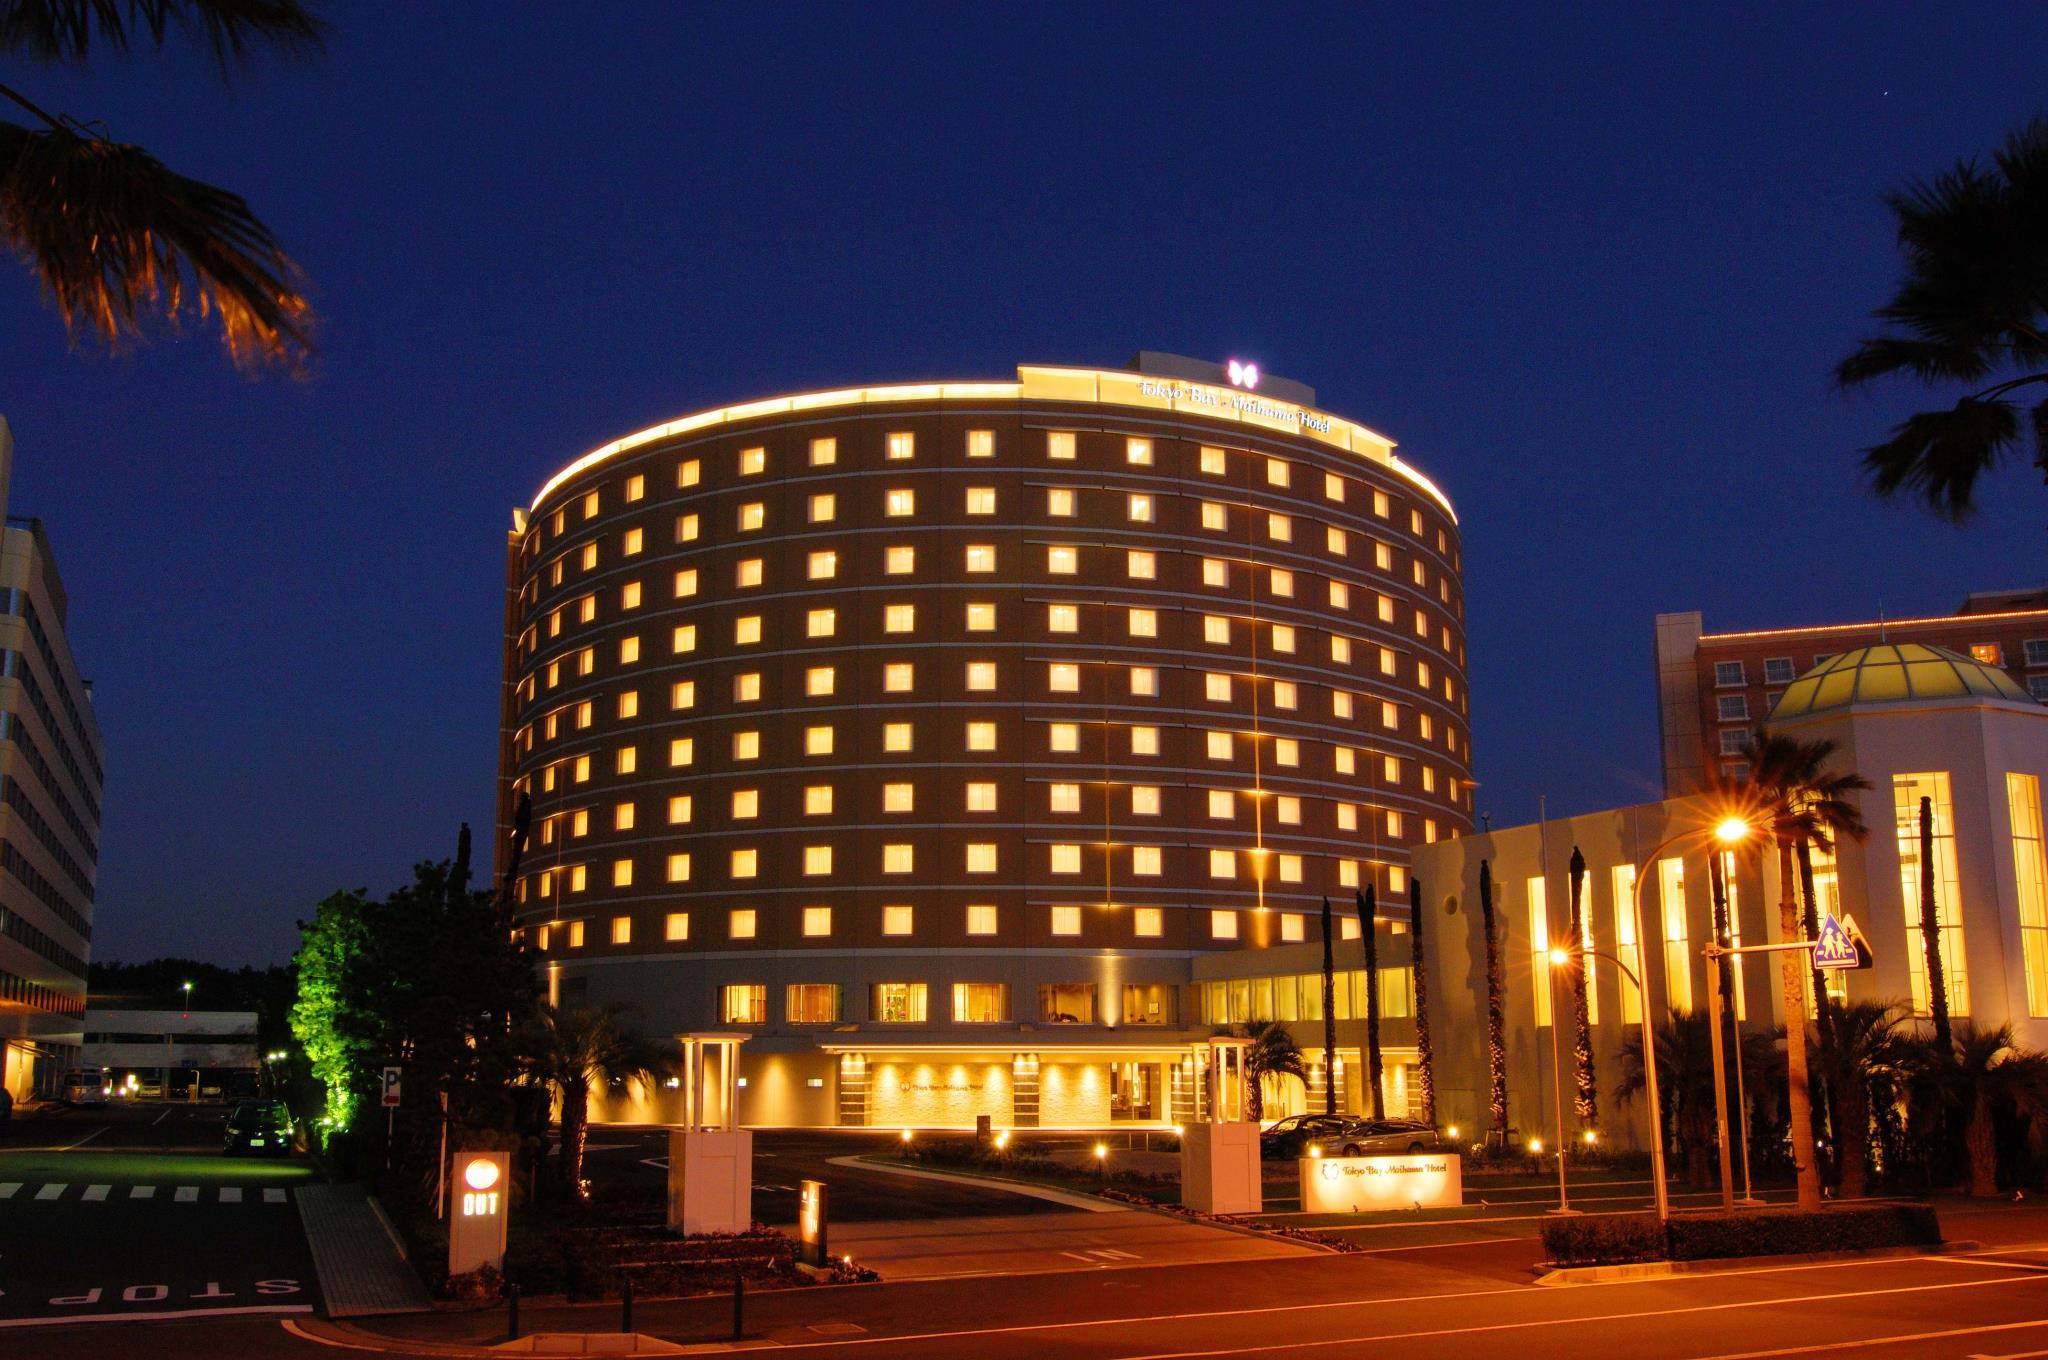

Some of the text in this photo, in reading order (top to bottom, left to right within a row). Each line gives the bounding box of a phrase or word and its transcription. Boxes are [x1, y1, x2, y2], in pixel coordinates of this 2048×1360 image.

[1138, 382, 1331, 433] Tokyo Bay Maihama Hotel
[385, 1071, 400, 1093] P
[1342, 1162, 1447, 1178] Tokyo Bay Maihama Hotel
[463, 1193, 499, 1216] OUT
[48, 1279, 301, 1305] STOP
